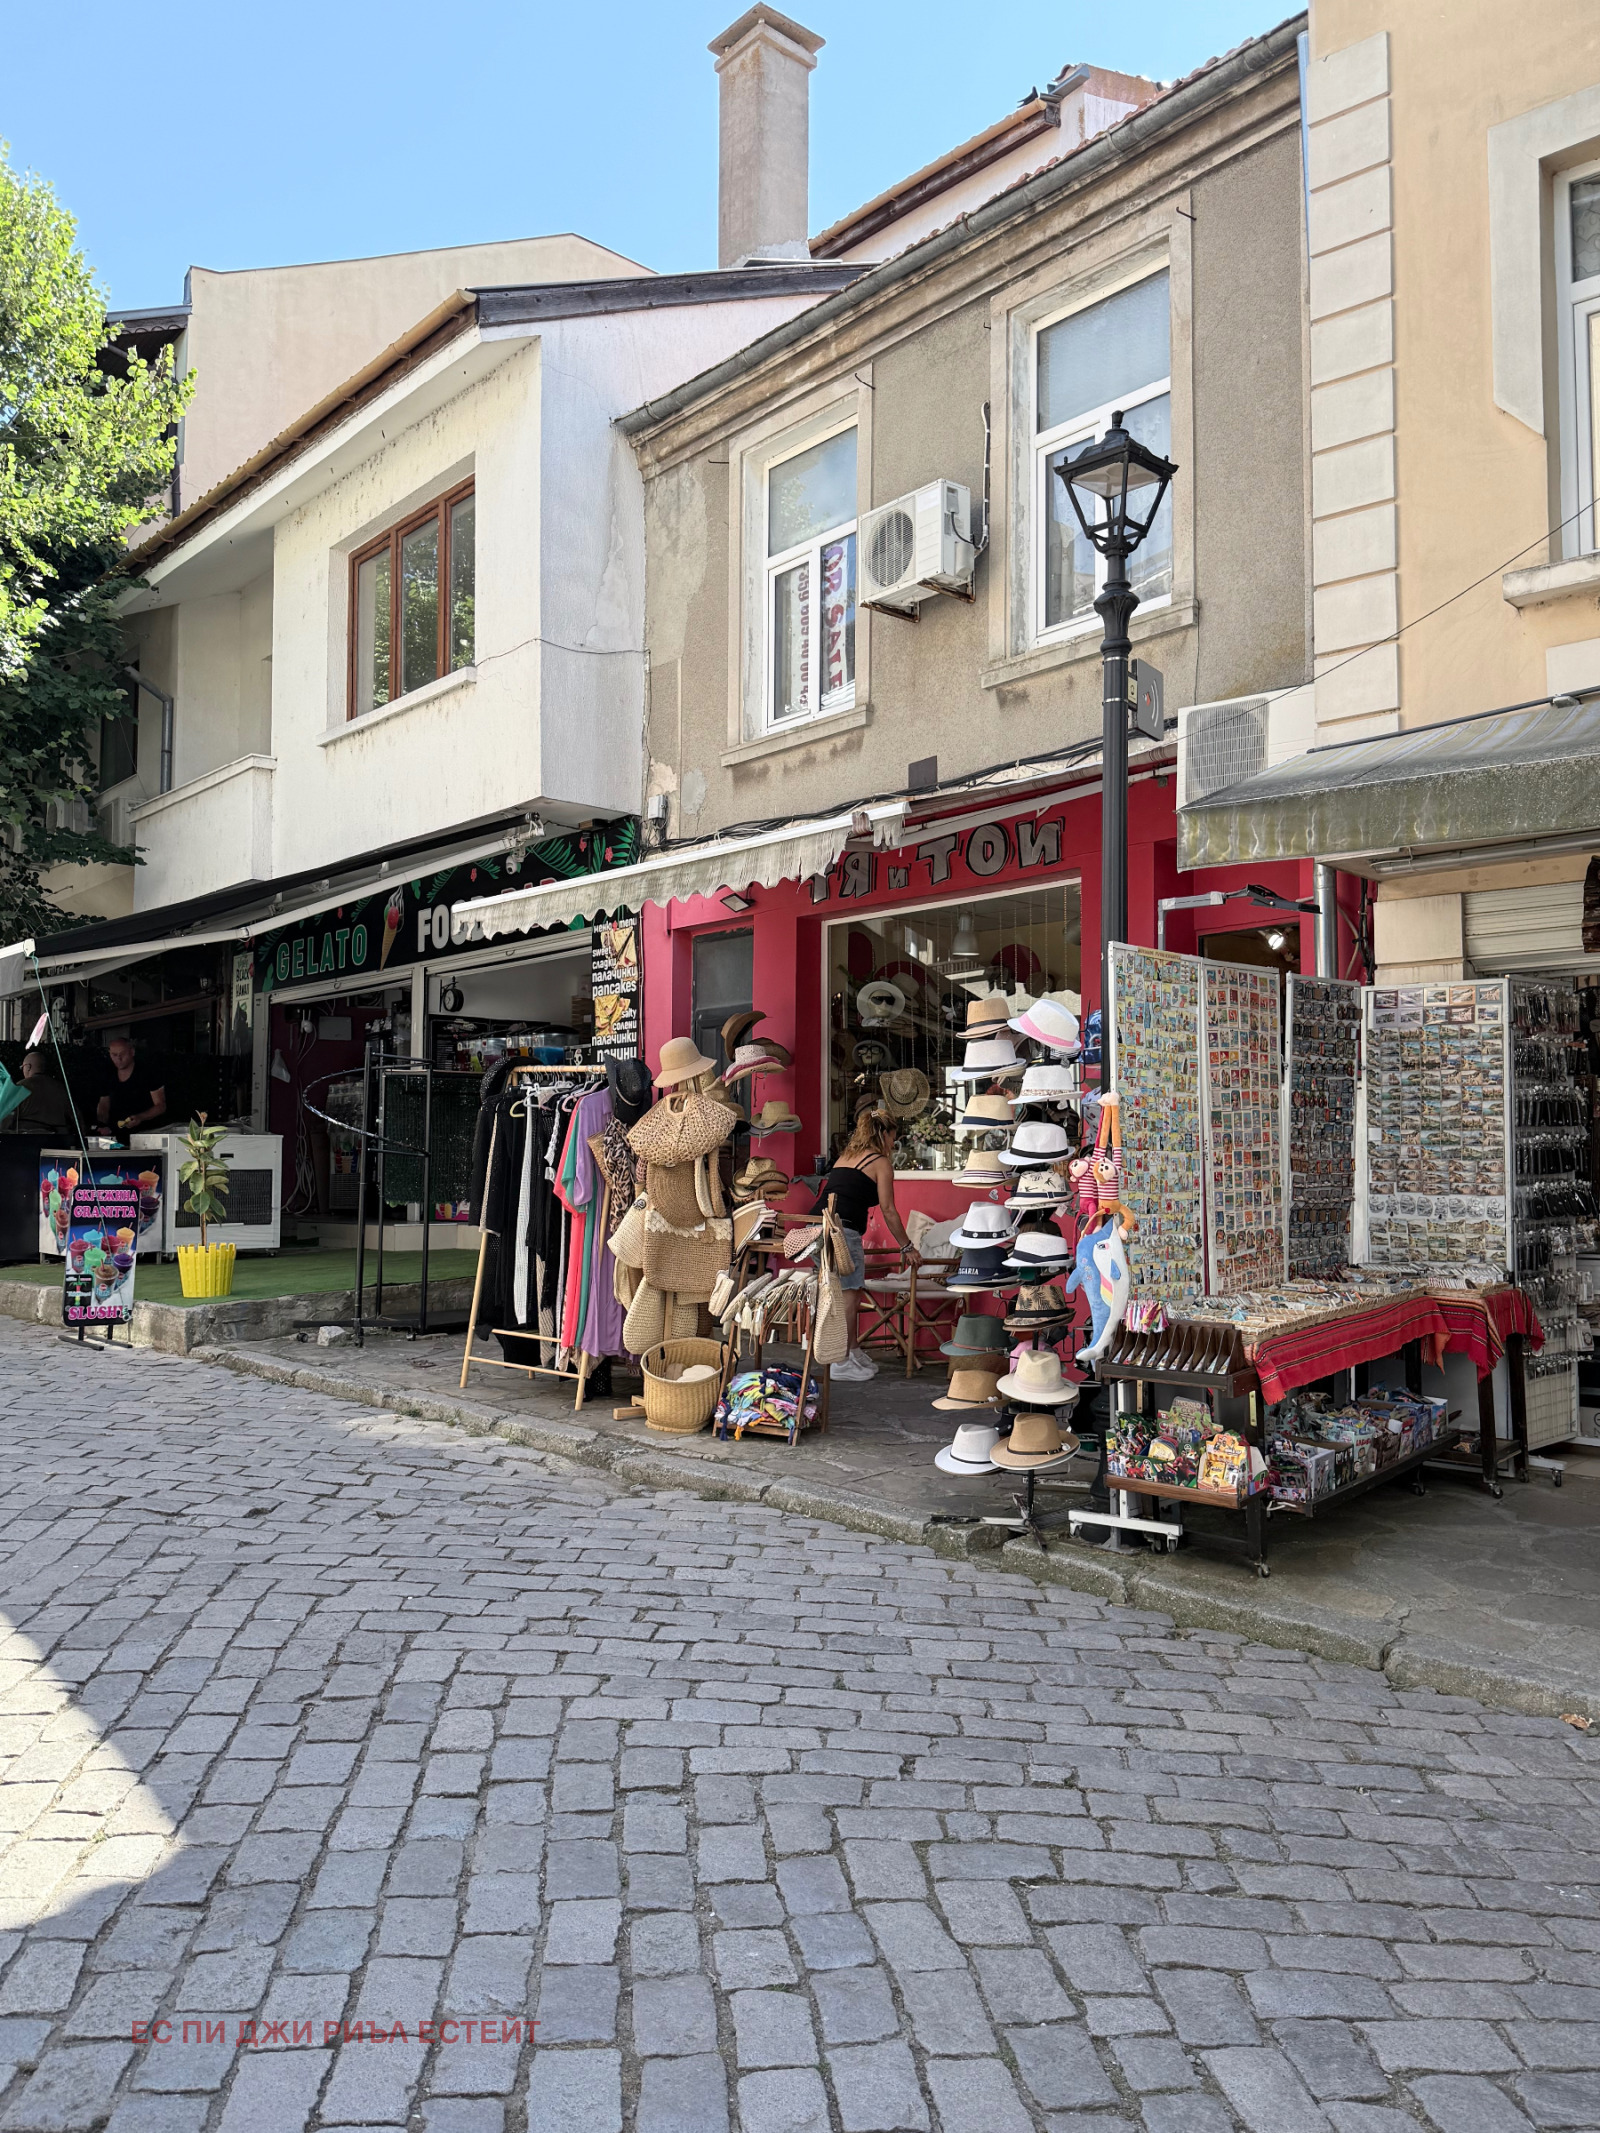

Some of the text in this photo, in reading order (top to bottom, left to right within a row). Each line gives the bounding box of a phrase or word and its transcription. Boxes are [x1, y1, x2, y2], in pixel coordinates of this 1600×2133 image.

[823, 541, 844, 691] OR SALE
[276, 924, 367, 981] GELATO
[592, 946, 612, 957] sweet
[592, 979, 637, 1001] pancakes
[621, 1007, 637, 1020] salty
[73, 1205, 137, 1218] GRANITTA
